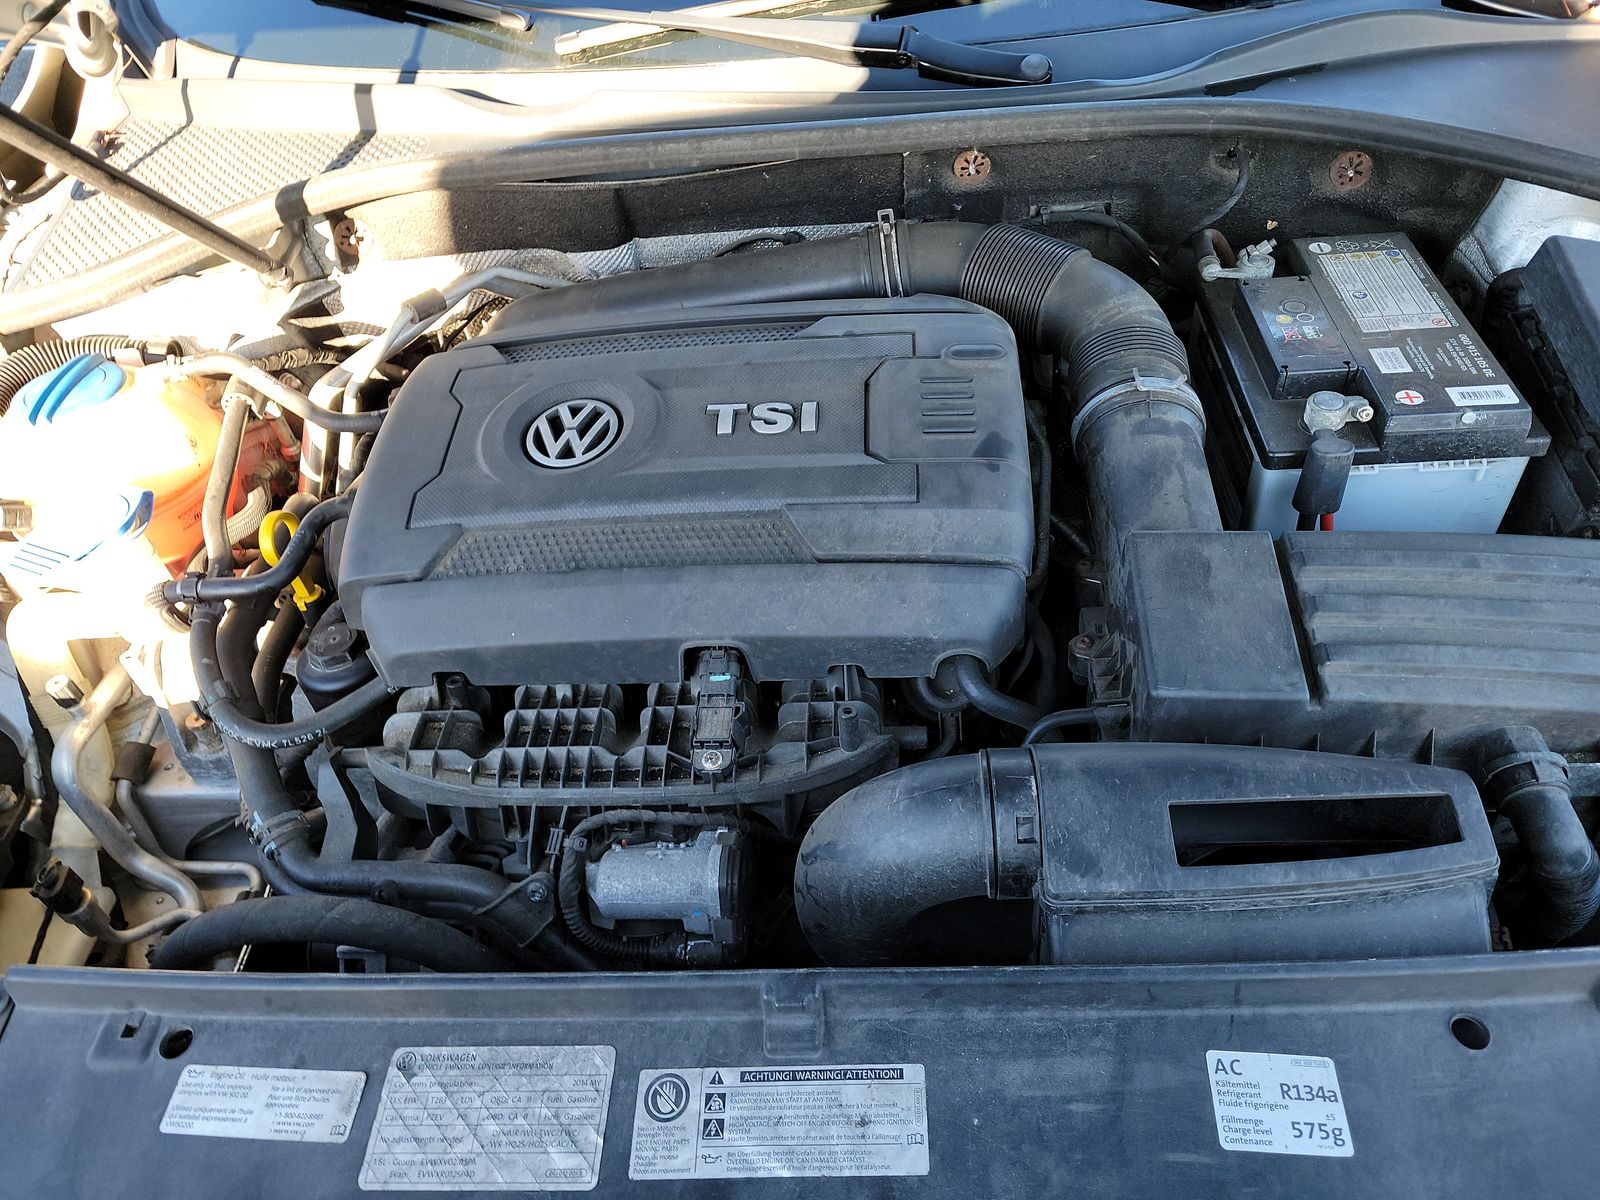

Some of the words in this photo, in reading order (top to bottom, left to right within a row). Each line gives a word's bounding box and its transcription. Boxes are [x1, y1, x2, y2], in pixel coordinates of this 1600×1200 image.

[1465, 345, 1481, 356] 915
[1473, 356, 1489, 368] 105
[1481, 368, 1496, 377] DE
[705, 402, 819, 435] TSI
[420, 1053, 477, 1062] VOLKSWAGEN
[418, 1063, 443, 1071] VEHICLE
[509, 1062, 553, 1070] INFORMATION
[1215, 1058, 1243, 1075] AC
[210, 1072, 233, 1082] Engine
[251, 1073, 270, 1081] Huile
[744, 1070, 793, 1082] ACHTUNG!
[796, 1070, 844, 1081] WARNING!
[846, 1069, 900, 1080] ATTENTION!
[572, 1080, 589, 1088] 2014
[1215, 1080, 1260, 1090] Kältemittel
[1217, 1090, 1262, 1099] Refrigerant
[1280, 1083, 1339, 1103] R134a
[512, 1096, 522, 1104] CA
[567, 1095, 597, 1104] Gasoline
[1219, 1099, 1243, 1107] Fluide
[1244, 1101, 1289, 1111] frigorigène
[508, 1113, 519, 1121] CA
[564, 1113, 595, 1121] Gasoline
[1221, 1116, 1264, 1126] Füllmenge
[1223, 1126, 1253, 1135] Charge
[1291, 1121, 1345, 1147] 575g
[391, 1135, 434, 1146] adjustments
[1224, 1136, 1273, 1146] Contenance
